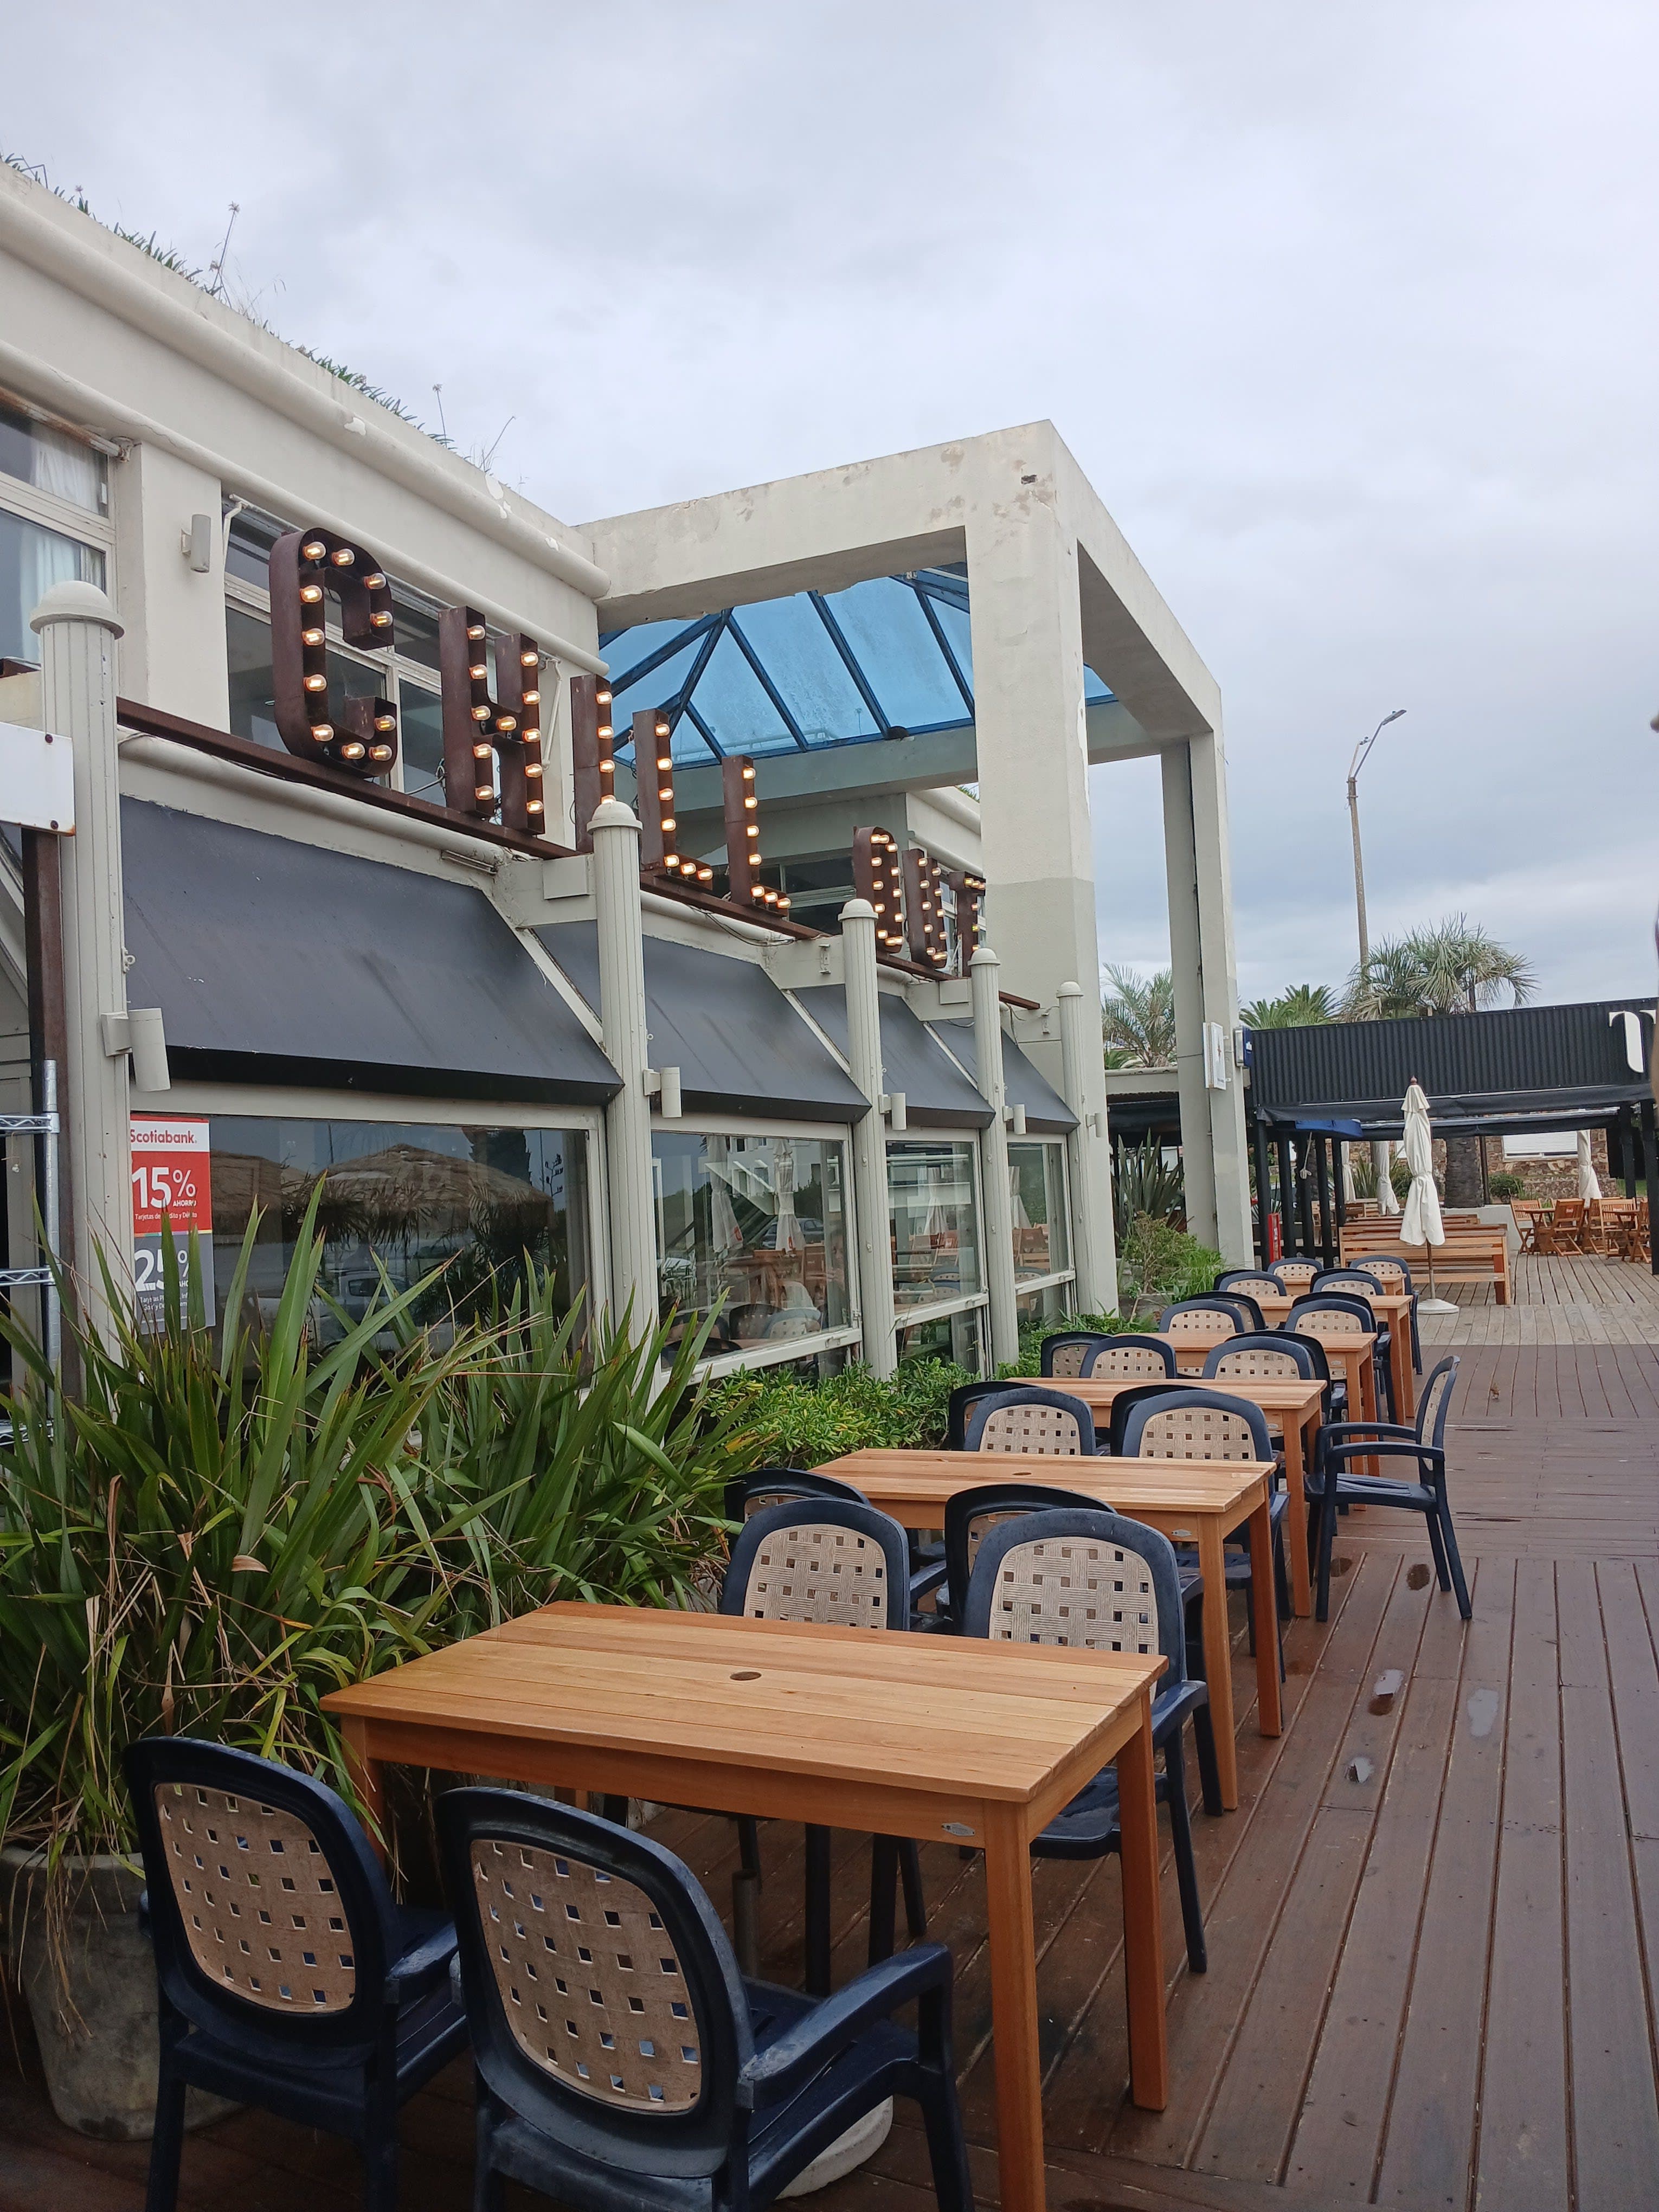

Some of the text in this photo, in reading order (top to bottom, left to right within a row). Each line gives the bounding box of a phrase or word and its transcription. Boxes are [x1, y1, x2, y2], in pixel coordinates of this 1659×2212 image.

[130, 1129, 194, 1143] Scotiabank
[132, 1167, 196, 1208] 15%
[135, 1213, 154, 1221] Tarjetas
